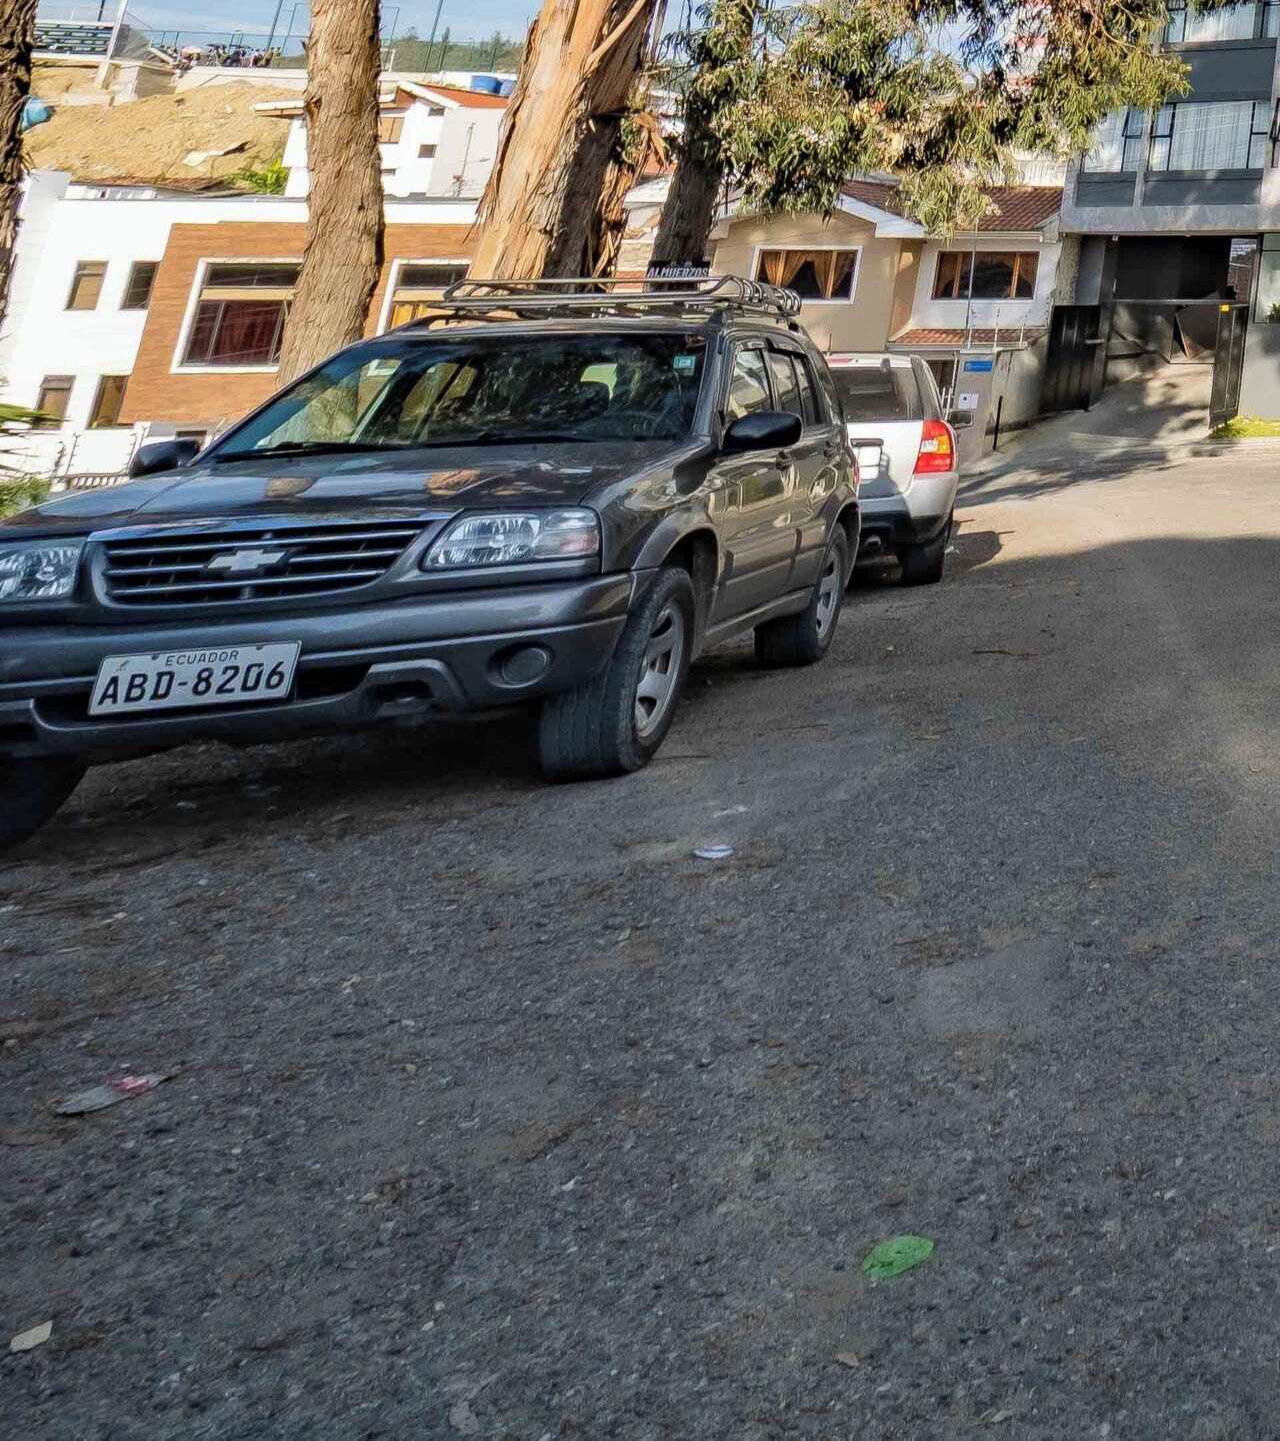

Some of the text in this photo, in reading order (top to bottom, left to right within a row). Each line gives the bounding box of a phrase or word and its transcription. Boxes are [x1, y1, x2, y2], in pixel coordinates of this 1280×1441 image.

[646, 267, 708, 278] ALMUERZOS
[165, 650, 240, 667] ECUADOR
[97, 661, 285, 706] ABD-8206
